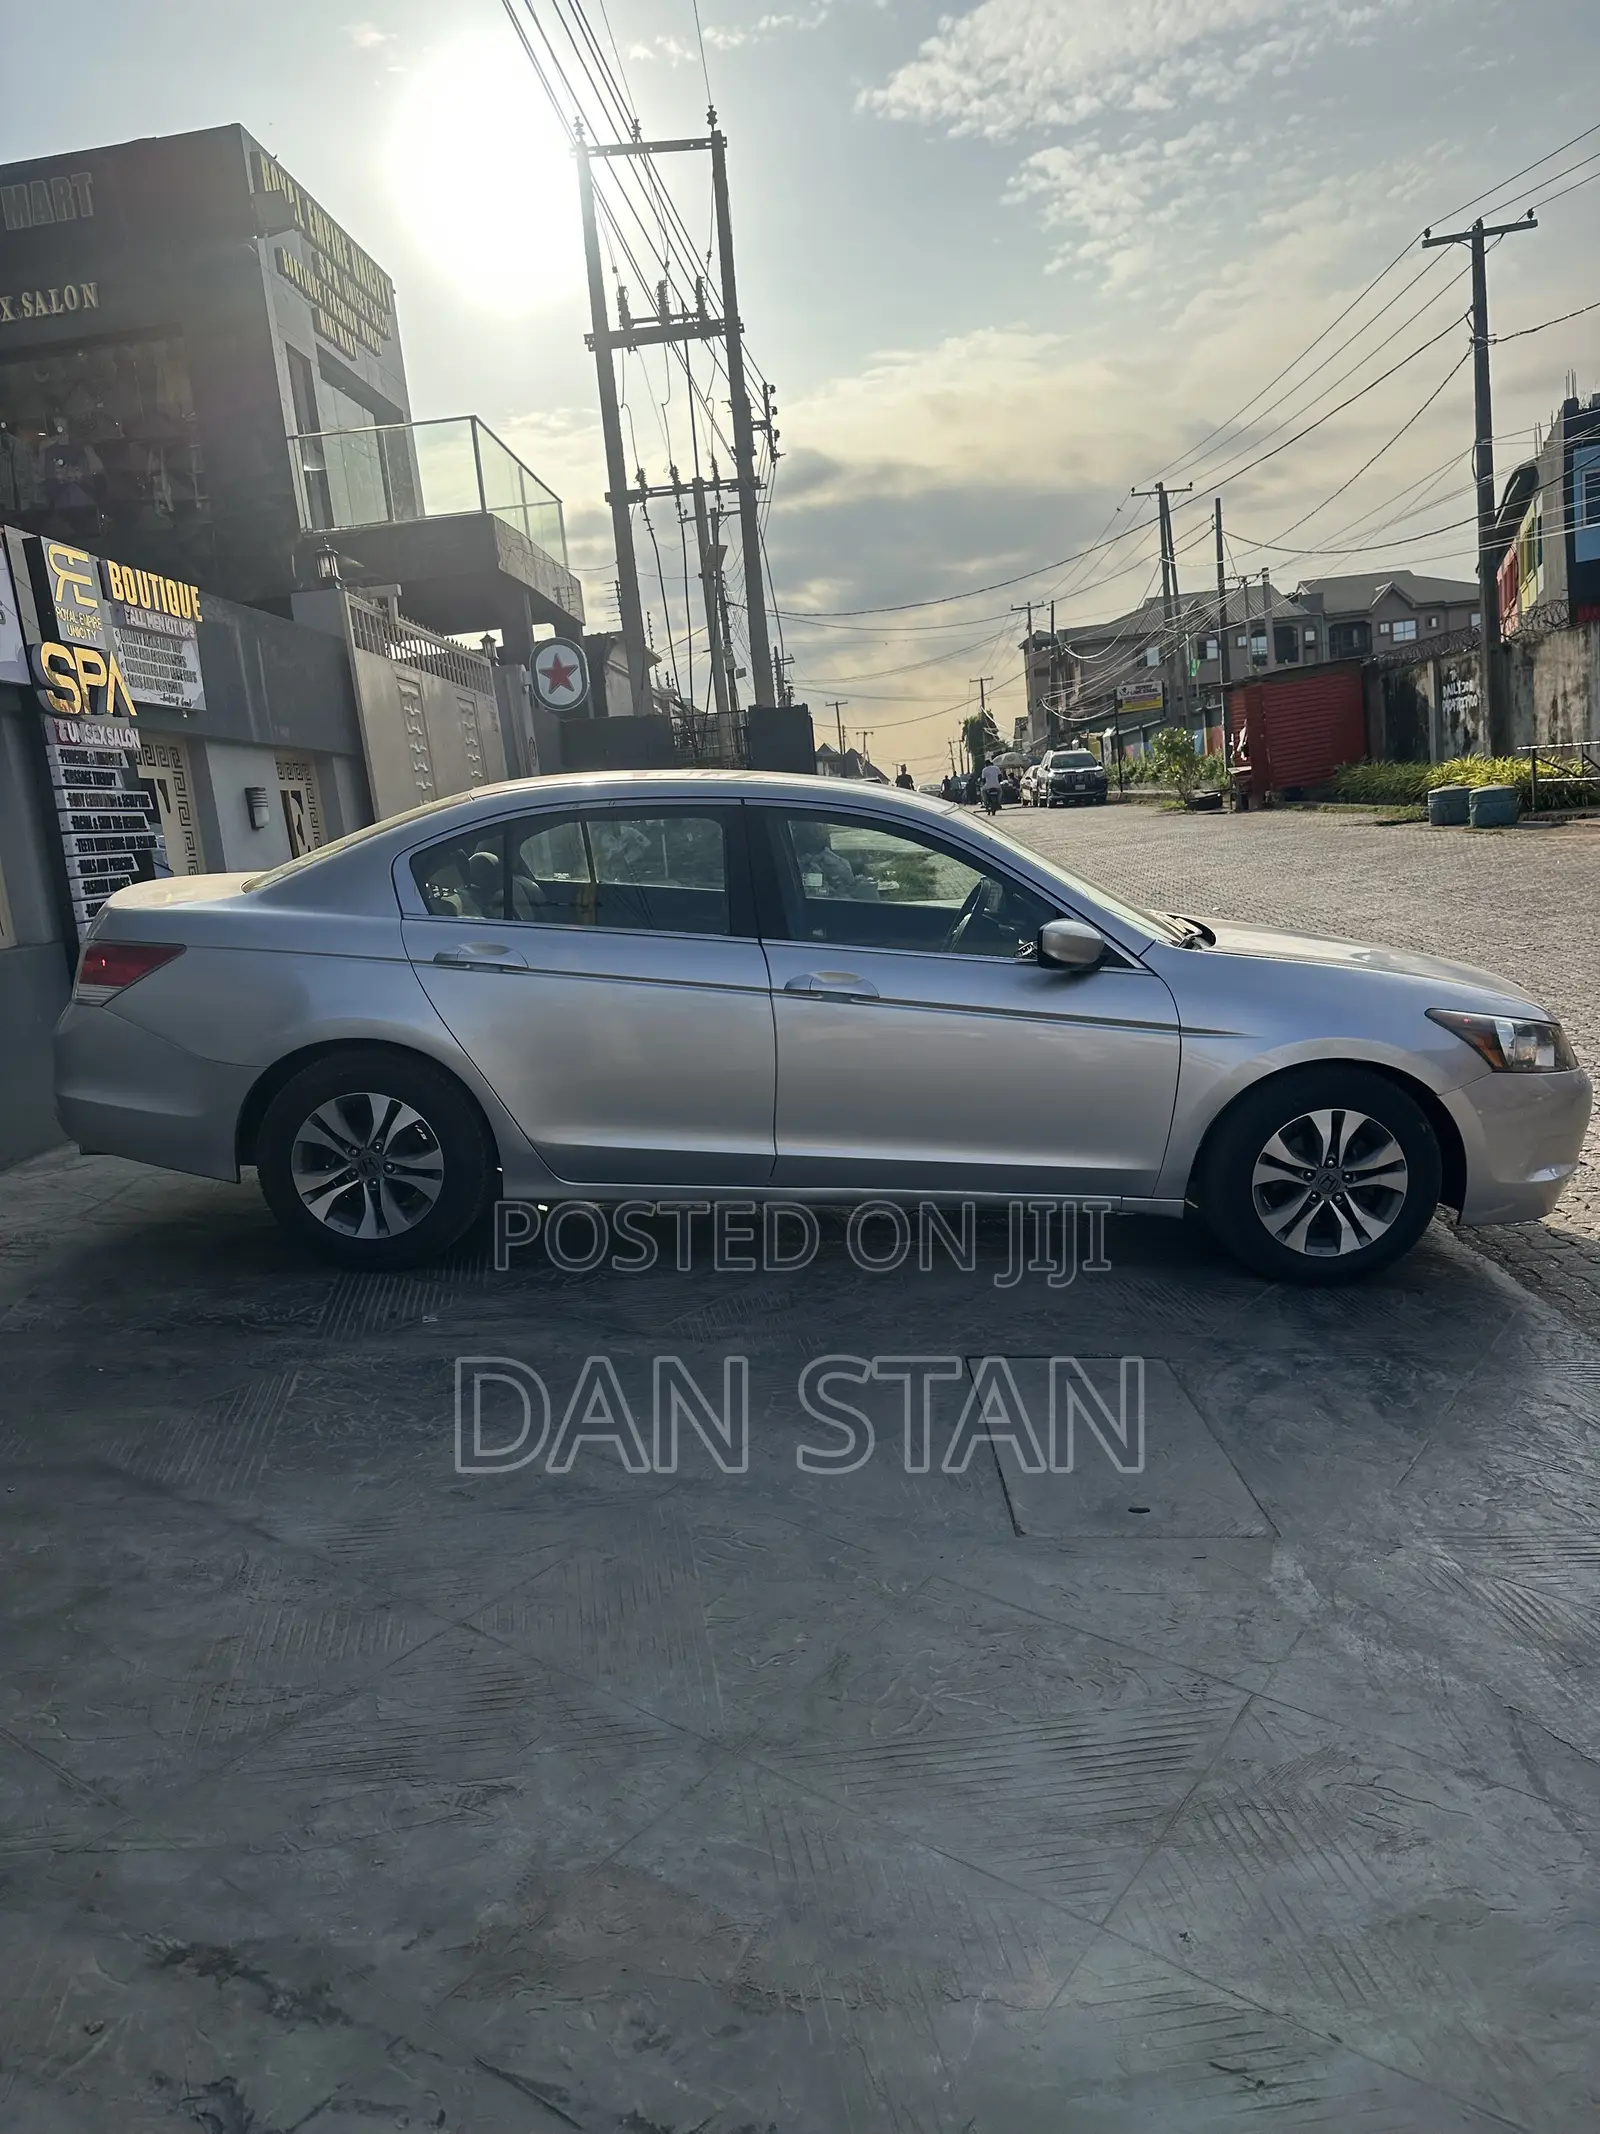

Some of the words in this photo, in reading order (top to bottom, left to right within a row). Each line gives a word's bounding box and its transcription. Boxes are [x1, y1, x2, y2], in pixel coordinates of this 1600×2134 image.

[0, 172, 94, 230] MART
[306, 199, 349, 274] EMPIRE
[282, 247, 321, 303] BOUTIQUE
[318, 251, 342, 296] SPA
[21, 282, 100, 317] SALON
[107, 559, 204, 623] BOUTIQUE
[67, 625, 97, 642] UNICITY
[79, 612, 102, 631] EMPIRE
[130, 608, 146, 627] ALL
[146, 612, 165, 632] MEN
[165, 616, 179, 635] KIT
[41, 641, 137, 716] SPA
[67, 721, 108, 746] UNISEX
[107, 727, 141, 749] SALON
